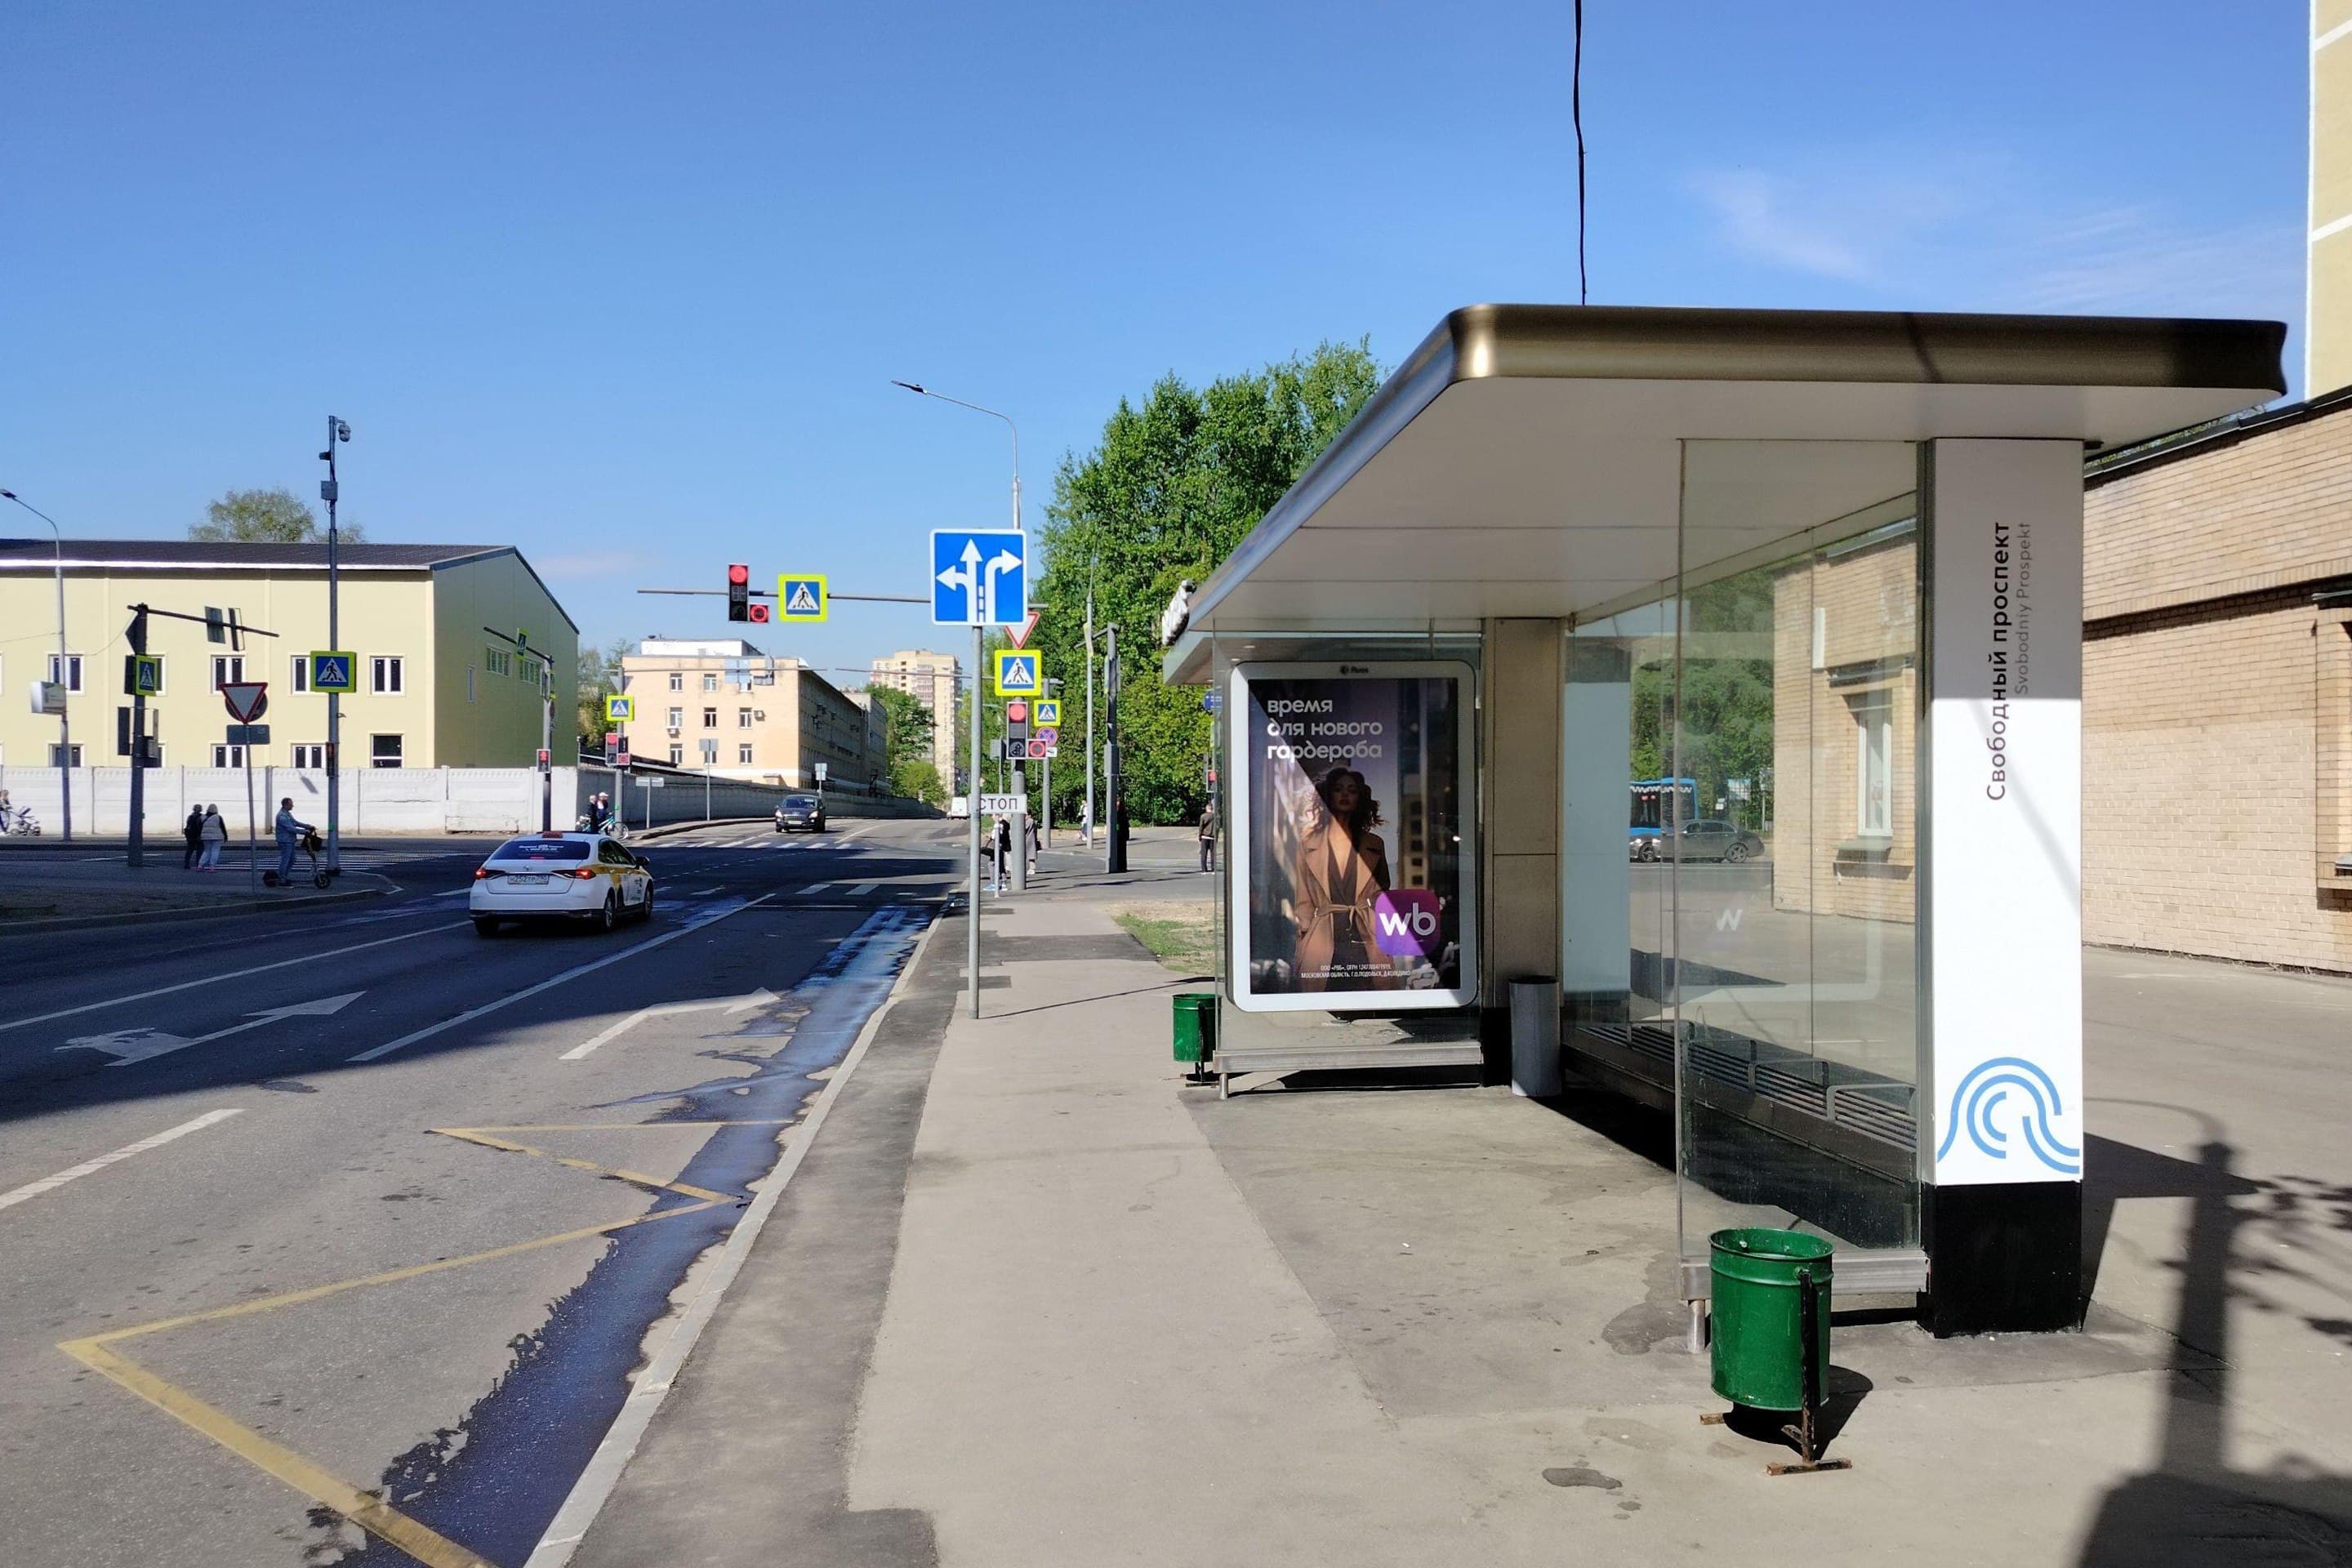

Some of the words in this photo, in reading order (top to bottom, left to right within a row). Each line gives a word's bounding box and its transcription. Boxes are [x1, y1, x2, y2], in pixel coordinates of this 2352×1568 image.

[2016, 522, 2032, 598] Prospekt
[1993, 522, 2012, 642] проспект
[2015, 604, 2032, 695] Svobodniy
[1267, 699, 1334, 717] время
[1267, 717, 1305, 737] для
[1311, 721, 1383, 736] нового
[1987, 652, 2010, 800] Свободный
[1267, 739, 1383, 764] гардероба
[980, 798, 1018, 810] СТОП
[1379, 902, 1437, 937] wb
